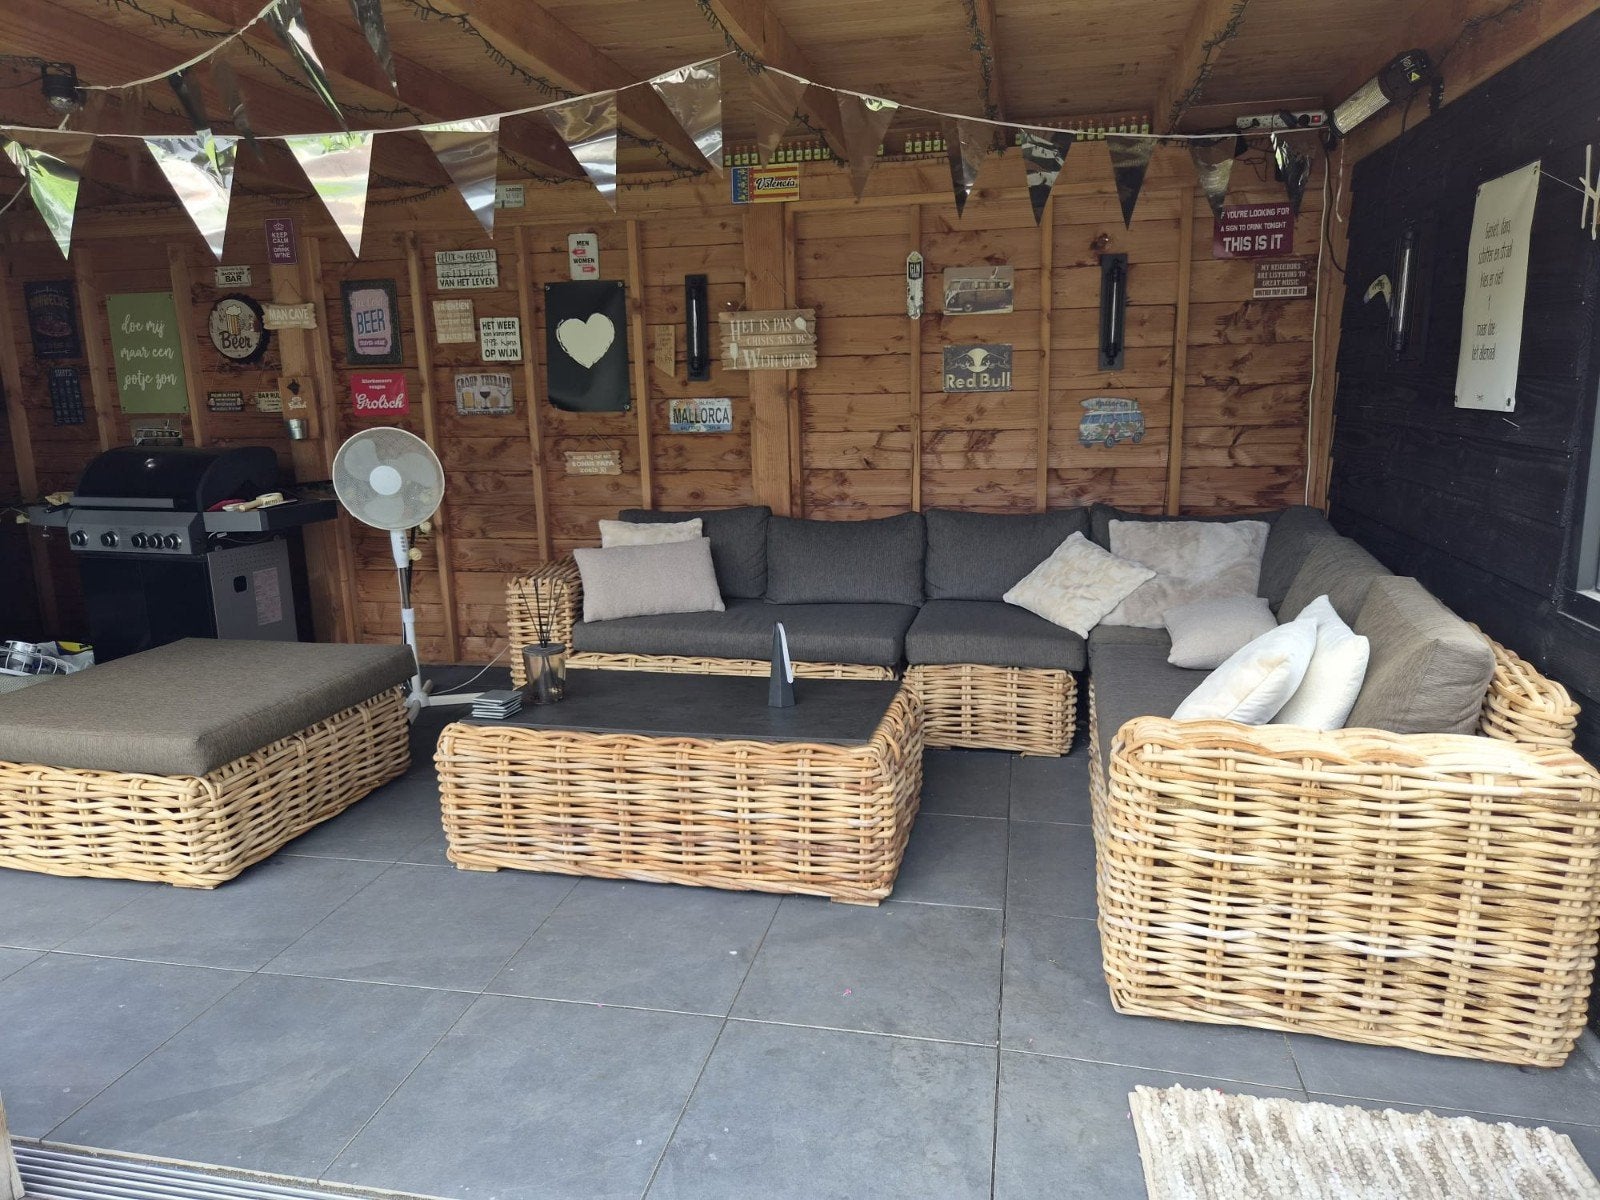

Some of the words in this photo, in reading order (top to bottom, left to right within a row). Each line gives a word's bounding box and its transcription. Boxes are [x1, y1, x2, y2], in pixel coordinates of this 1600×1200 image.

[755, 176, 796, 190] Valencia
[1227, 210, 1248, 219] YOU'RE
[1249, 208, 1276, 218] LOOKING
[1276, 207, 1290, 216] FOR
[1264, 221, 1287, 230] TONIGHT
[1223, 236, 1252, 252] THIS
[1254, 235, 1268, 251] IS
[1270, 234, 1284, 250] IT
[910, 264, 920, 273] GIN
[439, 279, 455, 287] VAN
[457, 278, 469, 286] HET
[472, 277, 496, 286] LEVEN
[1262, 279, 1281, 287] GREAT
[269, 309, 287, 320] MAN
[288, 309, 308, 320] CAVE
[356, 308, 386, 335] BEER
[122, 314, 144, 334] doe
[146, 320, 165, 338] mij
[482, 321, 495, 330] HET
[496, 320, 516, 329] WEER
[730, 319, 754, 341] HET
[759, 318, 770, 332] IS
[773, 317, 792, 332] PAS
[219, 330, 252, 349] Beer
[120, 346, 150, 361] maar
[152, 347, 174, 359] een
[484, 349, 496, 358] OP
[498, 348, 518, 357] WIJN
[742, 348, 778, 369] WIJN
[782, 354, 794, 368] OP
[800, 353, 810, 367] IS
[123, 370, 153, 391] potje
[945, 373, 976, 388] Red
[980, 372, 1011, 387] Bull
[356, 392, 405, 410] Grolsch
[672, 408, 730, 423] MALLORCA
